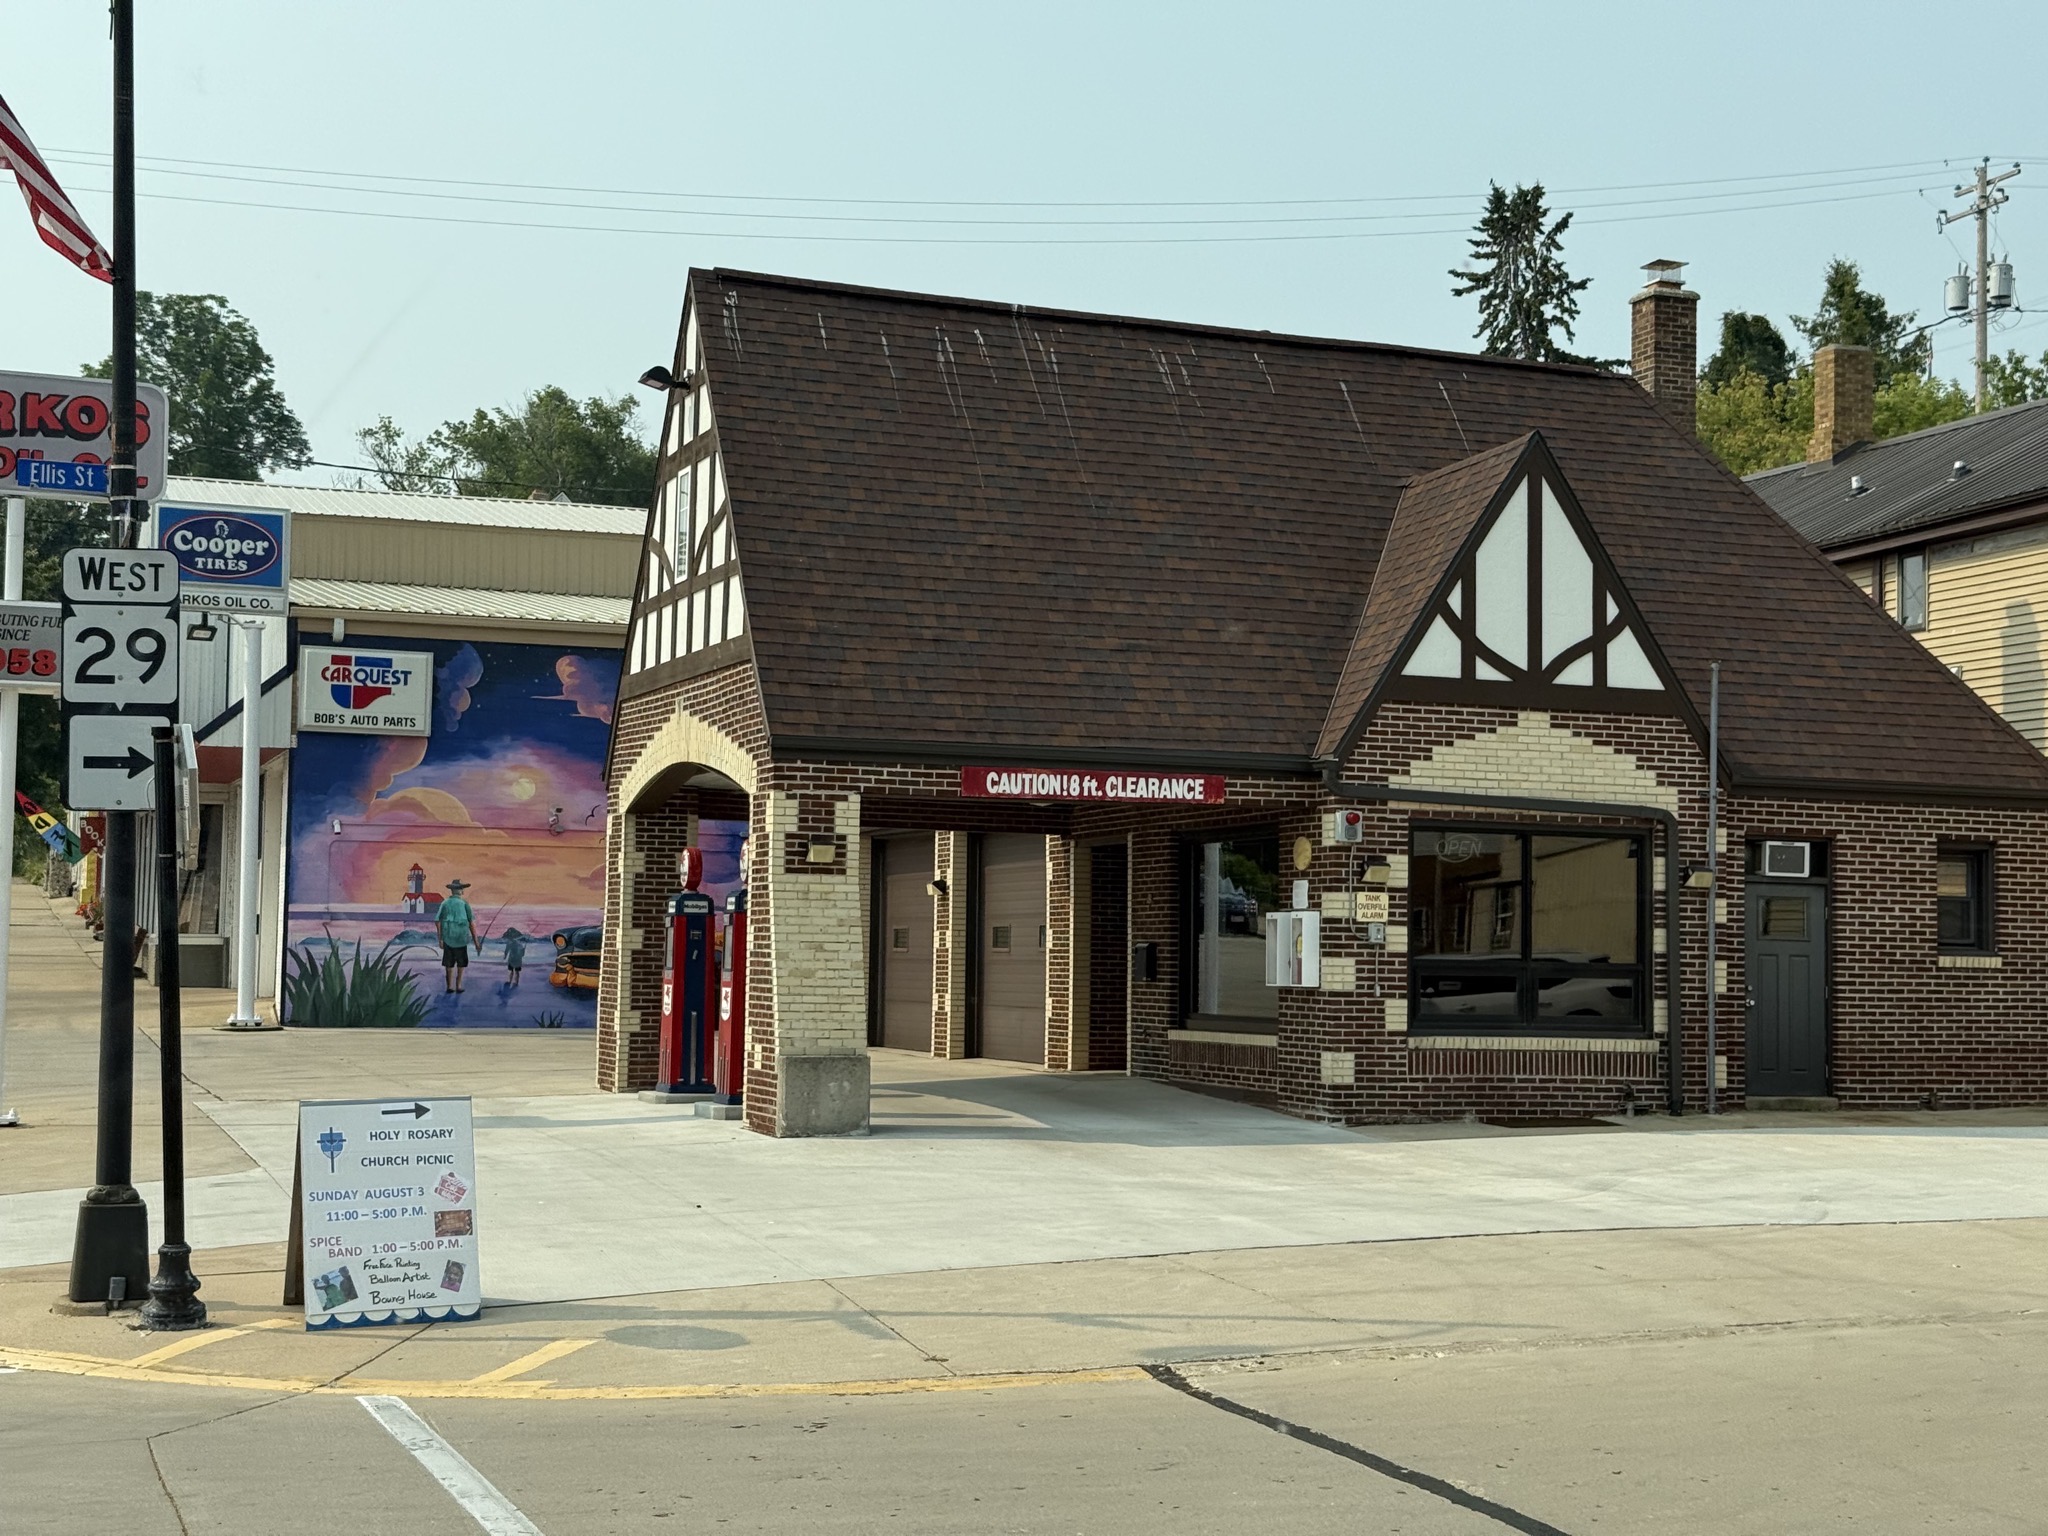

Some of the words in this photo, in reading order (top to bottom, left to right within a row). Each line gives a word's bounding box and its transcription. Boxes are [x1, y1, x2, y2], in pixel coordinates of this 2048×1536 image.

[30, 462, 66, 485] Ellis
[75, 466, 94, 487] St
[174, 529, 269, 558] Cooper
[195, 557, 248, 571] TIRES
[78, 556, 165, 592] WEST
[180, 594, 221, 607] RKOS
[224, 596, 246, 608] OIL
[250, 598, 274, 609] CO.
[0, 613, 39, 627] UTING
[75, 626, 167, 684] 29
[321, 666, 412, 687] CARQUEST
[314, 713, 345, 725] BOB'S
[350, 715, 379, 726] AUTO
[383, 716, 416, 728] PARTS
[1083, 775, 1103, 797] ft.
[1105, 775, 1205, 800] CLEARANCE
[1436, 839, 1482, 857] OPEN
[1364, 894, 1381, 902] TANK
[1357, 903, 1388, 911] OVERFILL
[1361, 911, 1384, 919] ALARM
[369, 1130, 400, 1141] HOLY
[408, 1129, 454, 1140] ROSARY
[361, 1155, 409, 1167] CHURCH
[416, 1154, 454, 1165] PICNIC
[309, 1190, 359, 1201] SUNDAY
[365, 1187, 413, 1199] AUGUST
[418, 1186, 425, 1197] 3
[326, 1210, 359, 1222] 11:00
[372, 1208, 397, 1219] 5:00
[401, 1206, 427, 1217] P.M.
[310, 1236, 342, 1248] SPICE
[328, 1247, 363, 1258] BAND
[372, 1243, 397, 1254] 1:00
[410, 1240, 434, 1251] 5:00
[437, 1239, 463, 1250] P.M.
[363, 1259, 379, 1270] Free
[369, 1274, 400, 1284] Balloon
[402, 1272, 431, 1282] Artist
[408, 1289, 437, 1300] House
